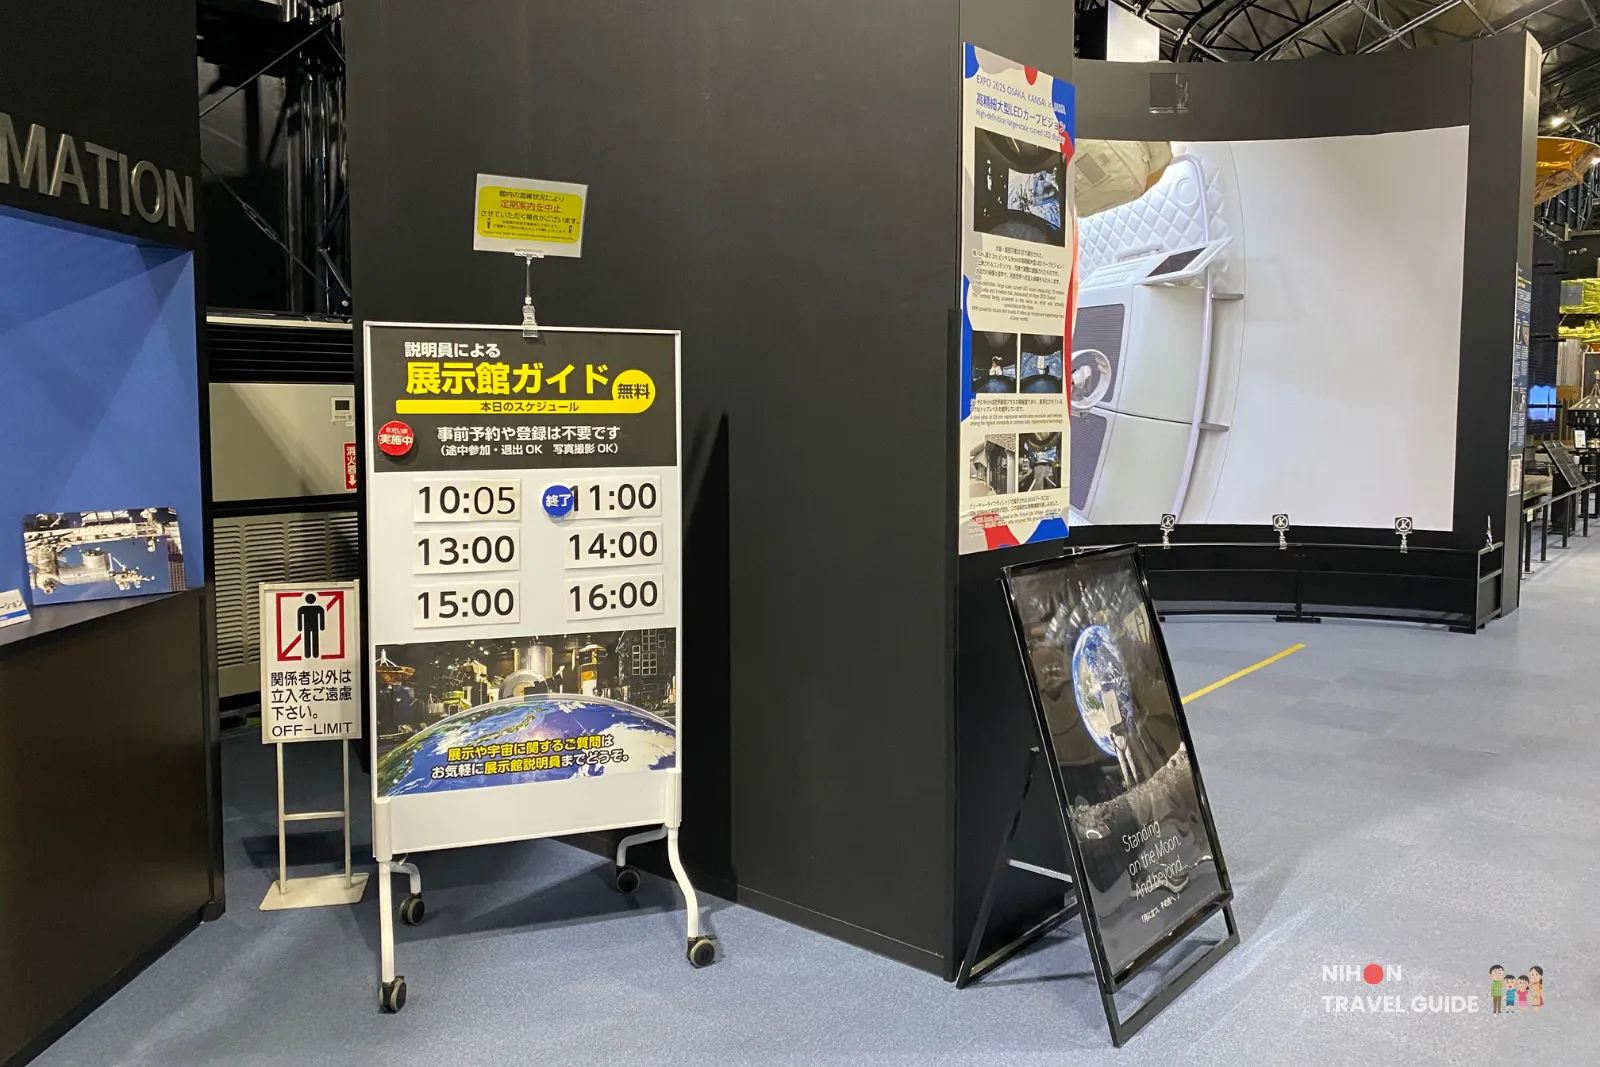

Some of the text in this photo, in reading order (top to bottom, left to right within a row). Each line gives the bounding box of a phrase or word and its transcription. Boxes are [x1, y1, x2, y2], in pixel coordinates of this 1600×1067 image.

[976, 74, 991, 88] EXPO
[993, 80, 1006, 93] 2025
[1007, 86, 1026, 101] OSAKA,
[1027, 93, 1047, 107] KANSAI
[976, 92, 1067, 133] 高精細大型LEDカーブビジョン
[0, 112, 194, 232] MATION
[499, 190, 564, 203] 館内の混雑状況により
[500, 199, 562, 213] 定期案内を中止
[480, 210, 580, 225] させていただく場合がございます。
[404, 342, 501, 359] 説明員による
[406, 361, 609, 395] 展示館ガイド
[617, 383, 650, 399] 無料
[480, 401, 579, 413] 本日のスケジュール
[379, 433, 413, 447] 実施中
[385, 426, 409, 435] ただいま
[437, 426, 621, 443] 事前予約や登録は不要です
[418, 486, 516, 515] 10:05
[545, 493, 572, 508] 終了
[569, 482, 657, 511] 11:00
[418, 535, 515, 565] 13:00
[569, 530, 658, 561] 14:00
[417, 588, 514, 619] 15:00
[569, 580, 658, 612] 16:00
[270, 669, 352, 686] 関係者以外は
[271, 686, 352, 704] 立入をご遠慮
[271, 705, 318, 721] 下さい。
[272, 722, 353, 737] OFF-LIMIT
[447, 735, 614, 762] 展示や宇宙に関するご質問は
[431, 752, 629, 779] お気軽に展示館説明員までどうぞ。
[1121, 820, 1161, 853] Standing
[1128, 860, 1142, 876] on
[1141, 850, 1156, 868] the
[1135, 876, 1153, 901] And
